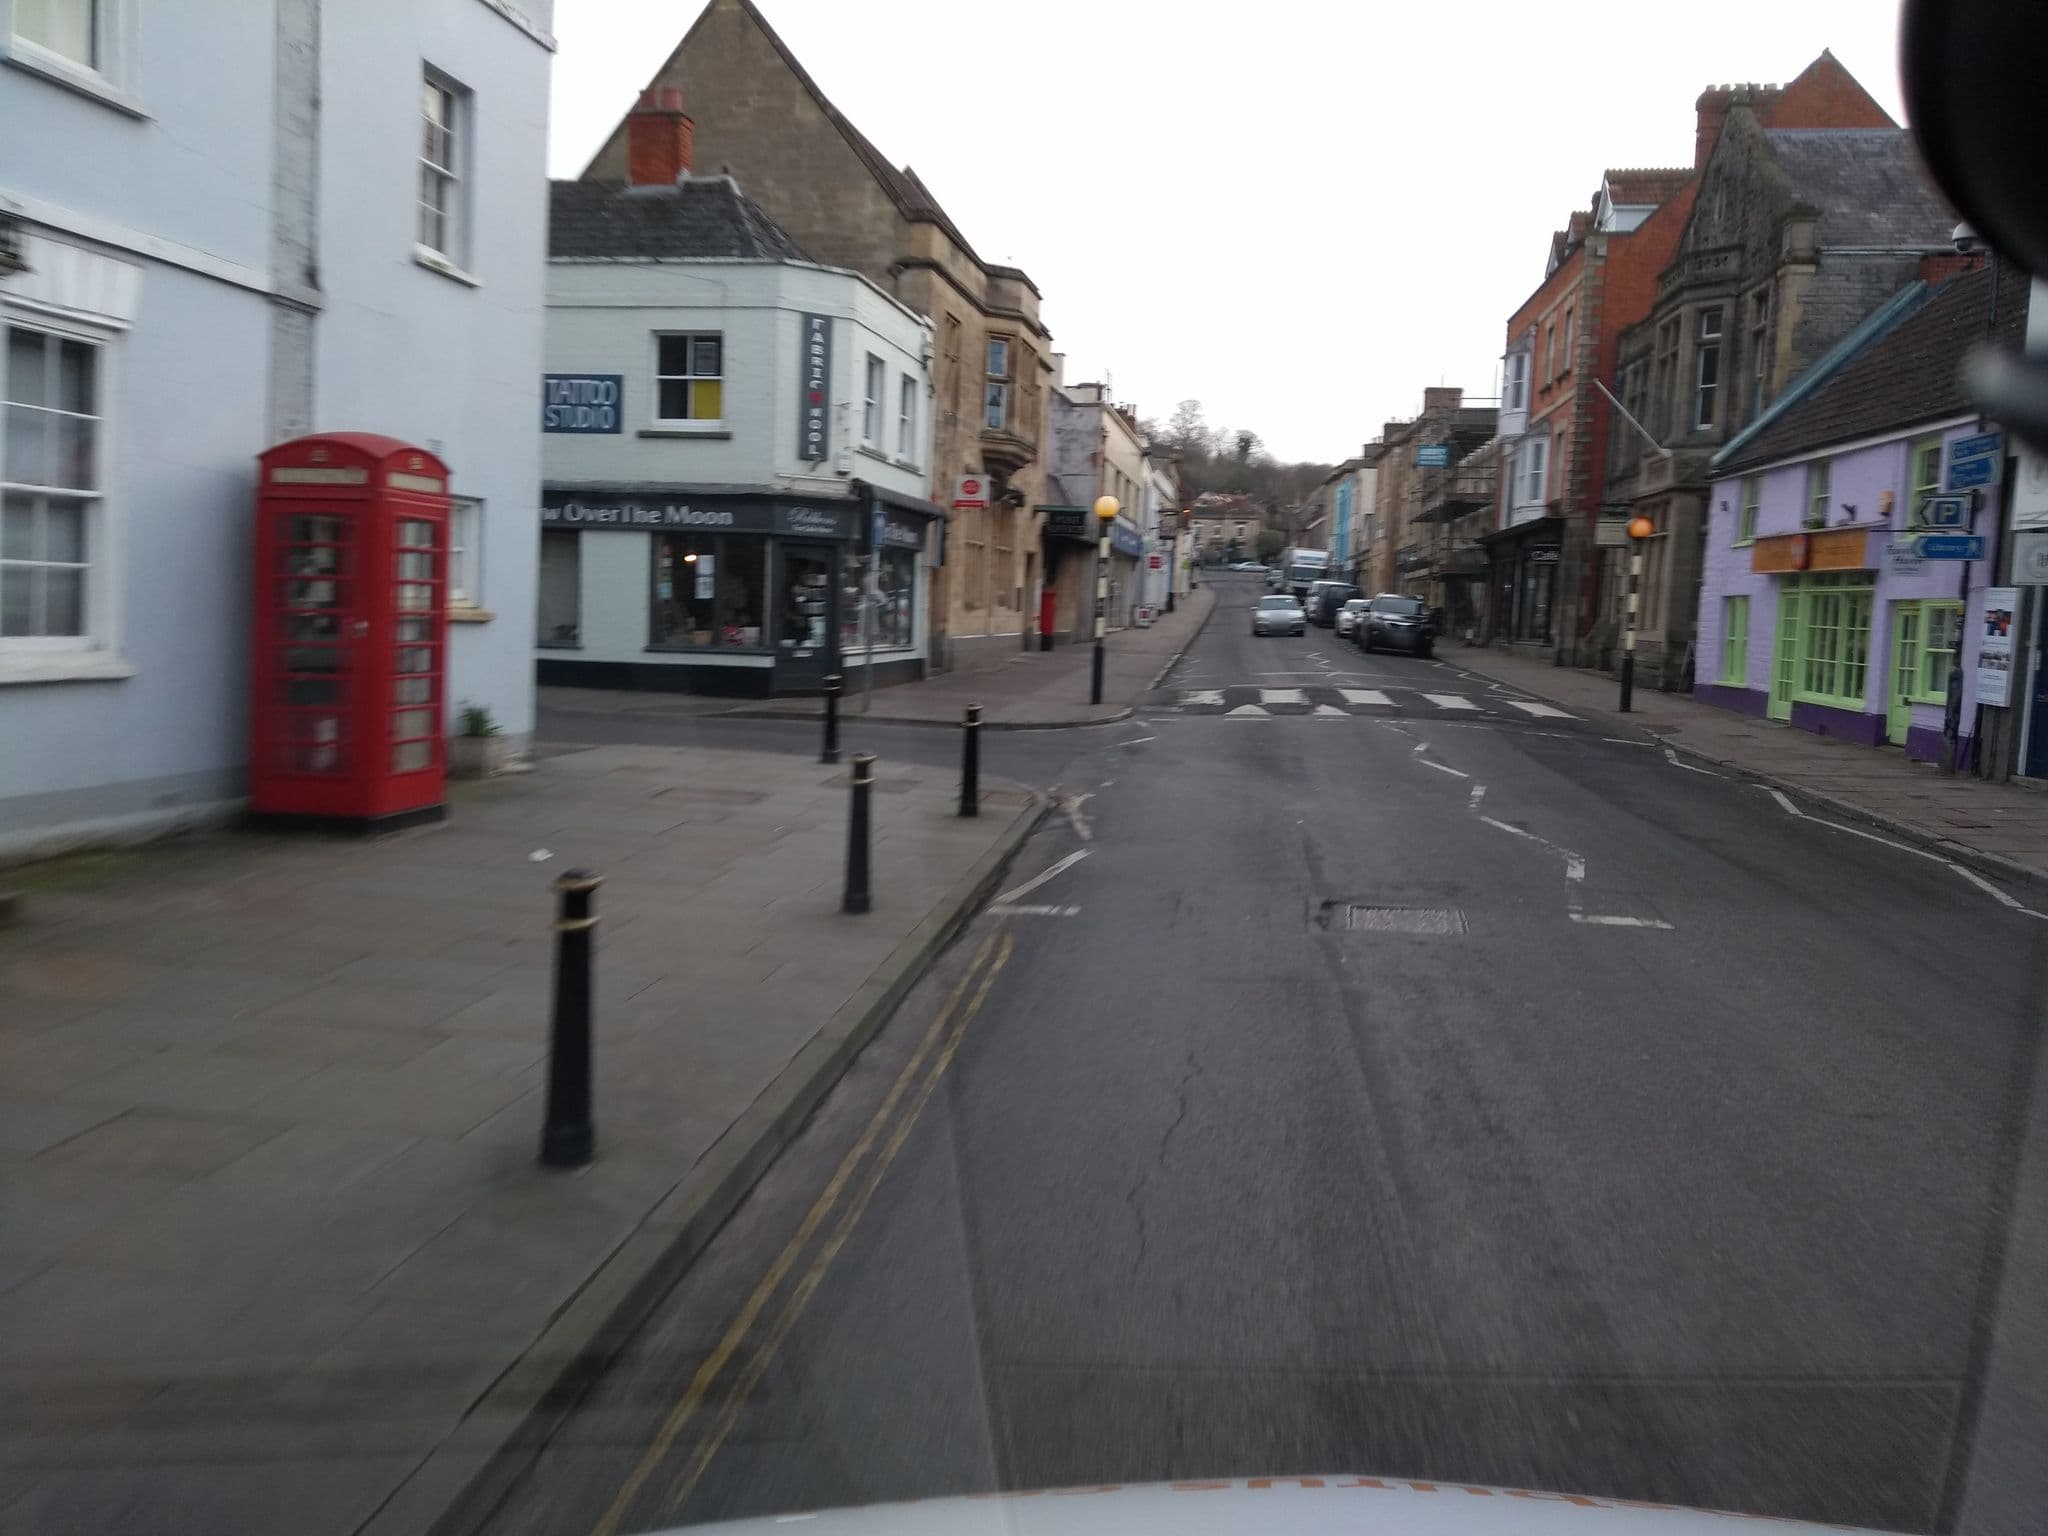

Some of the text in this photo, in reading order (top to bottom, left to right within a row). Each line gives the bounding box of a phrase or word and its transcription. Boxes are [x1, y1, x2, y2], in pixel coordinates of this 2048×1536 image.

[544, 404, 616, 429] STUDIO
[563, 503, 620, 522] Over
[664, 505, 733, 525] Moon
[1944, 502, 1958, 522] P
